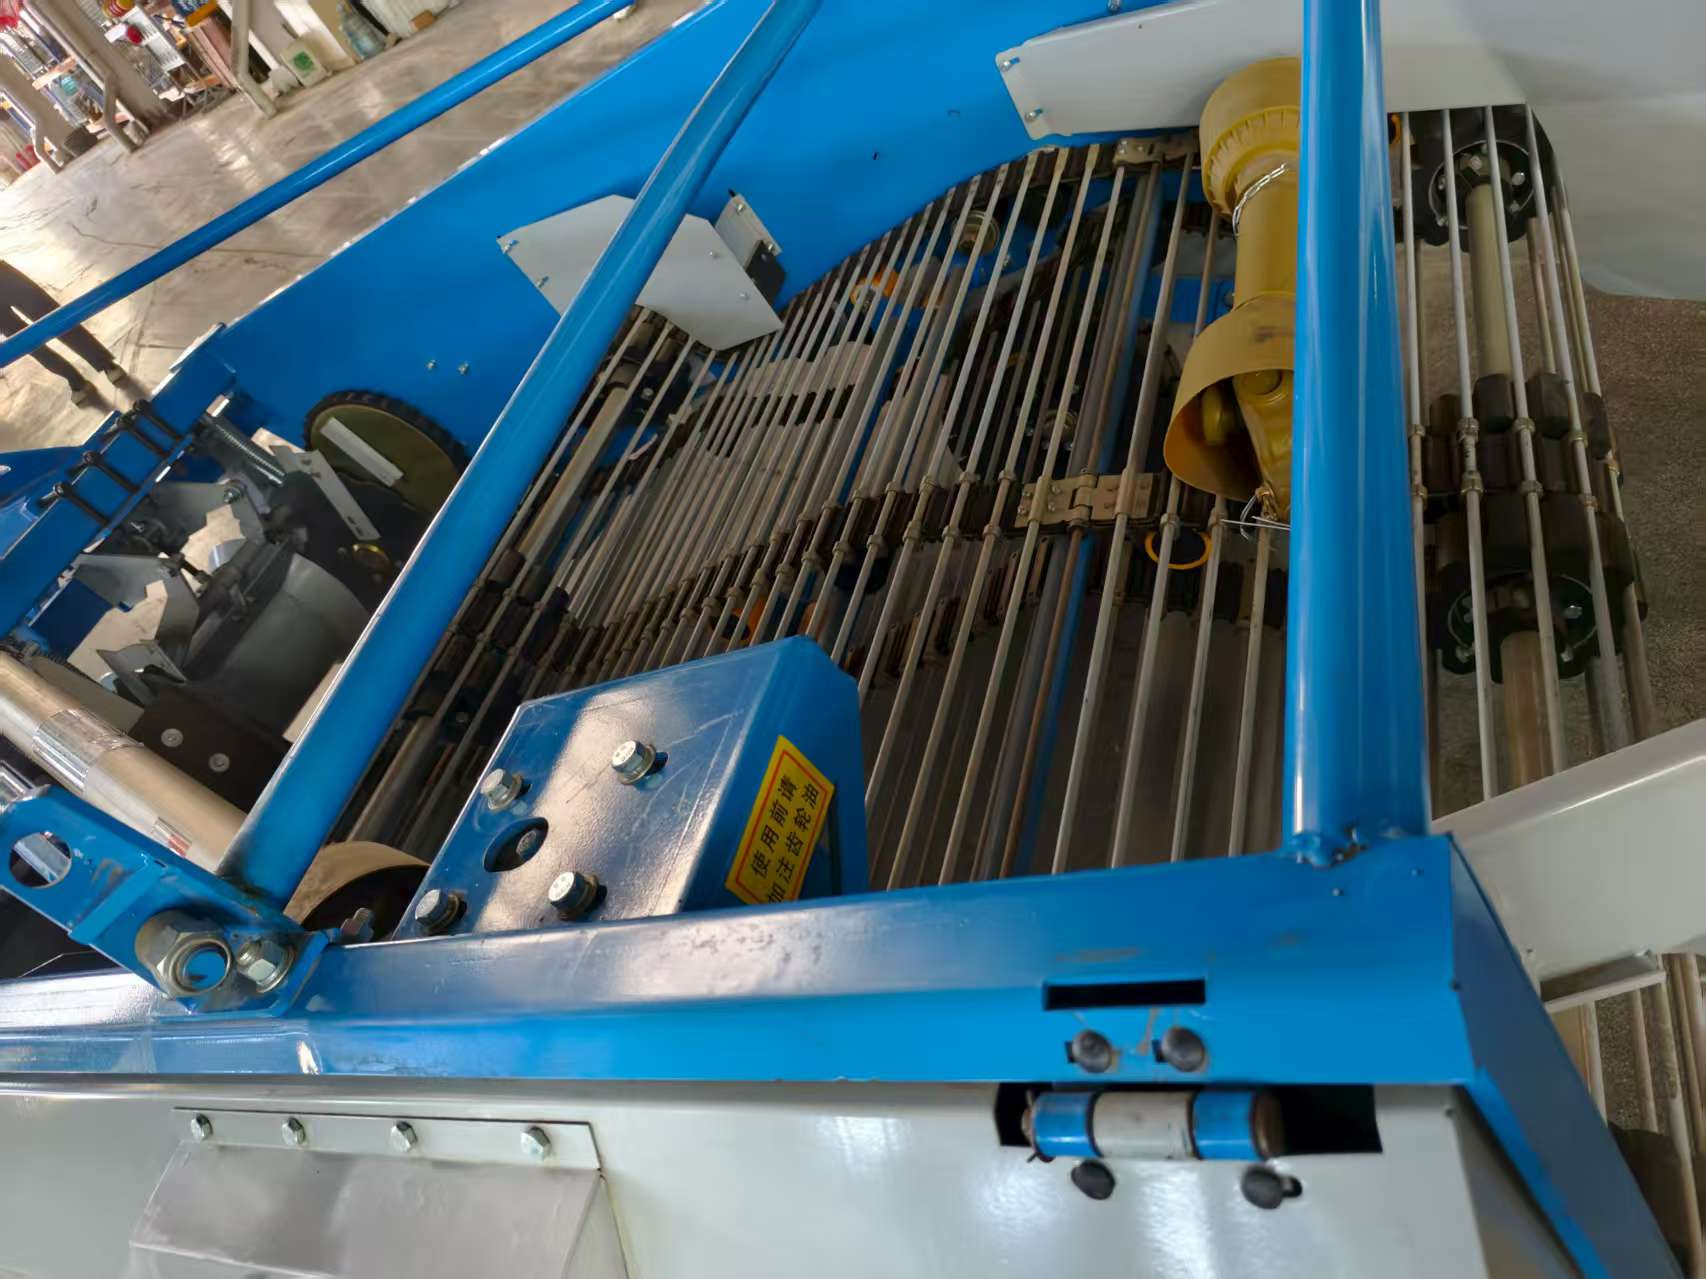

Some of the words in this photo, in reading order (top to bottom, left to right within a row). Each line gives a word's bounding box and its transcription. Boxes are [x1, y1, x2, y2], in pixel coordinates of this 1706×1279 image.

[751, 775, 797, 879] 使用前请
[768, 783, 819, 903] 加注齿轮油
